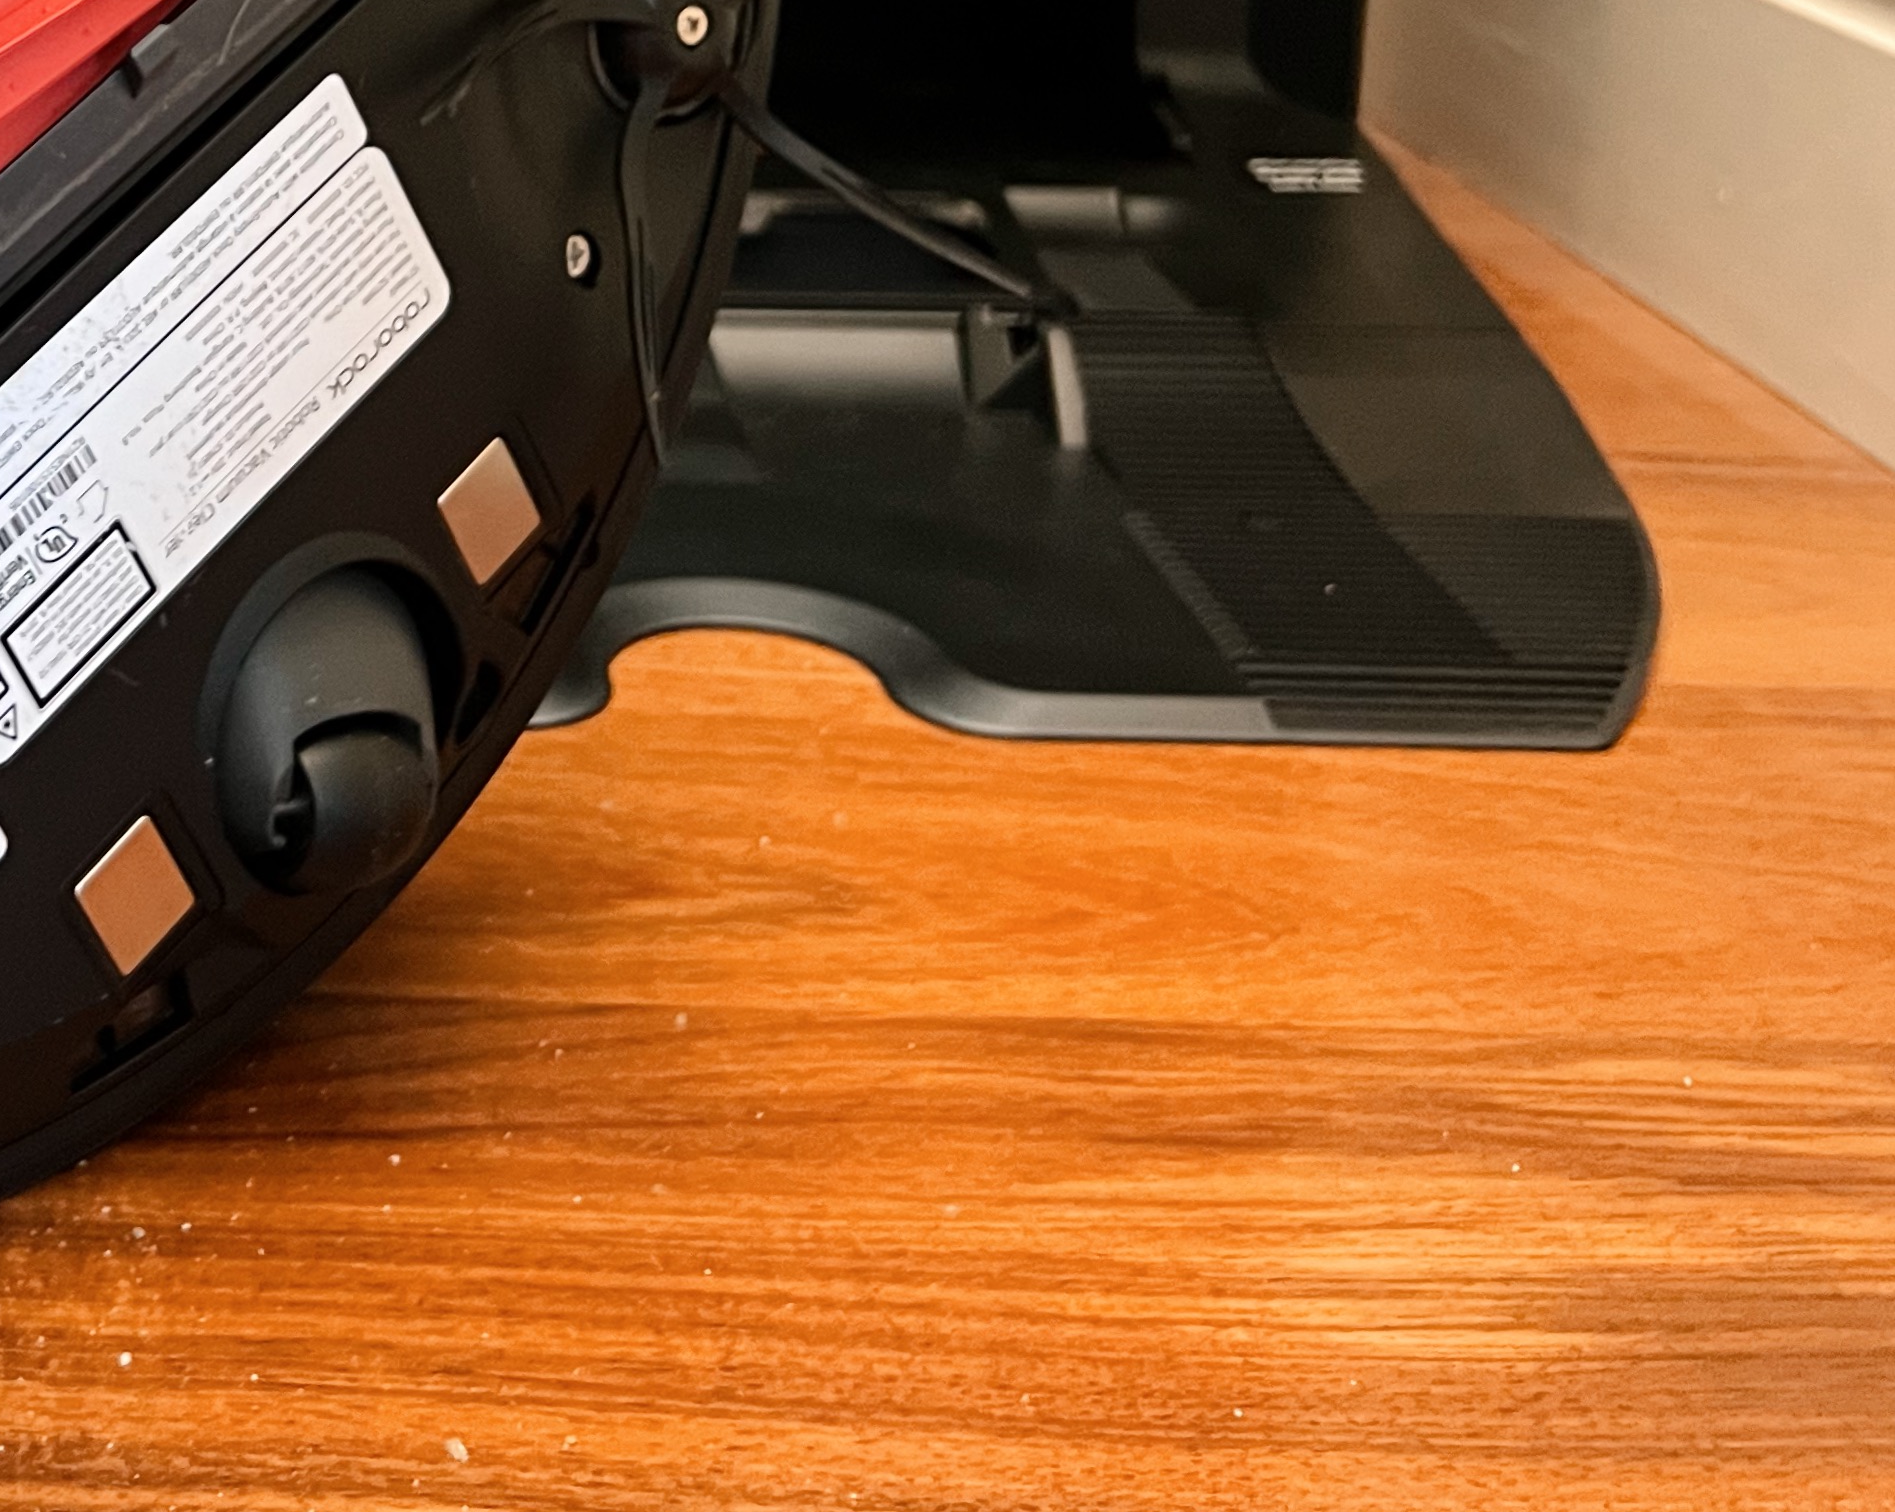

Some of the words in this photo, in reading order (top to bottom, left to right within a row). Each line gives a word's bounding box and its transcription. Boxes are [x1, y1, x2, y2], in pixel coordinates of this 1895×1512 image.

[324, 284, 434, 405] roborock
[268, 393, 322, 453] Robotic
[214, 443, 272, 508] Vacuum
